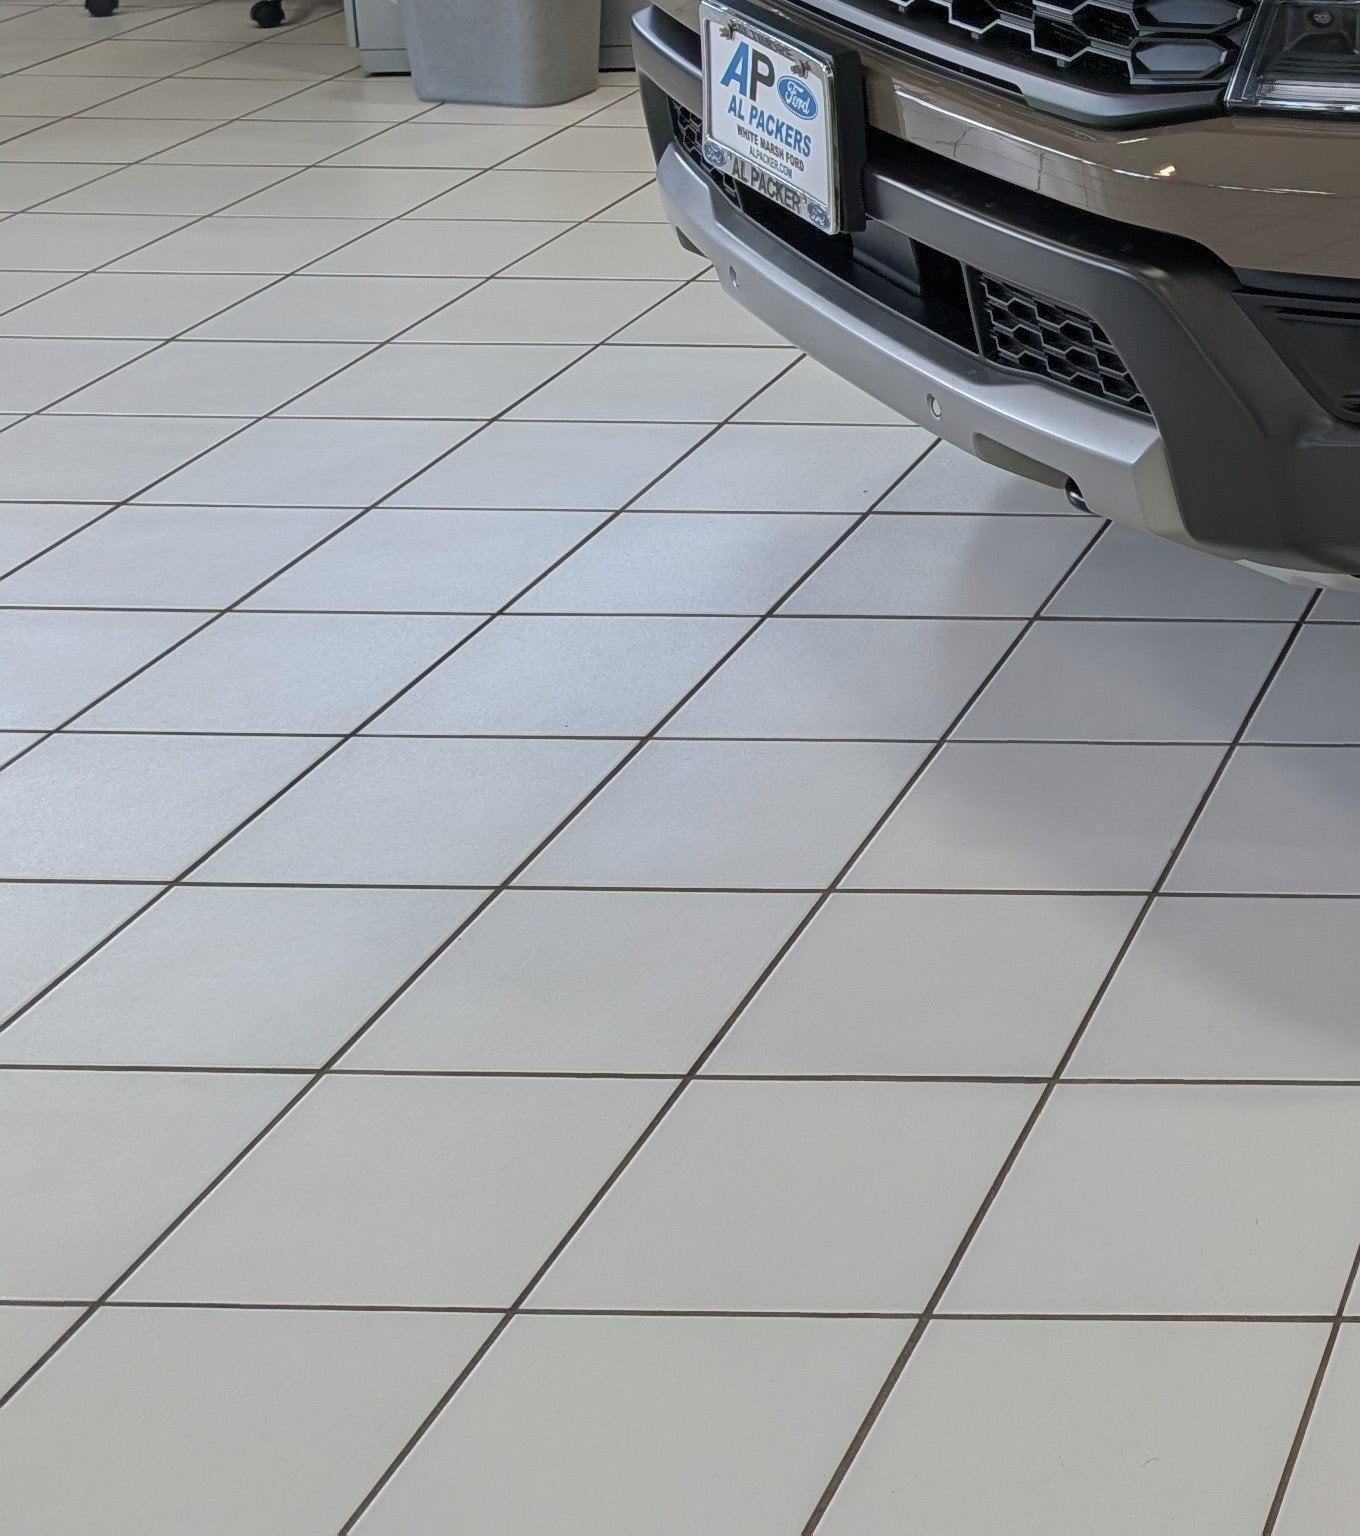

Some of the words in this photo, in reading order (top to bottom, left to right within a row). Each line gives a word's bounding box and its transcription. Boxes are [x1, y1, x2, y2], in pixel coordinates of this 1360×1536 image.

[720, 41, 775, 103] AP
[727, 94, 745, 122] AL
[749, 108, 812, 157] PACKERS
[737, 124, 759, 146] WHITE
[785, 150, 805, 173] FORD
